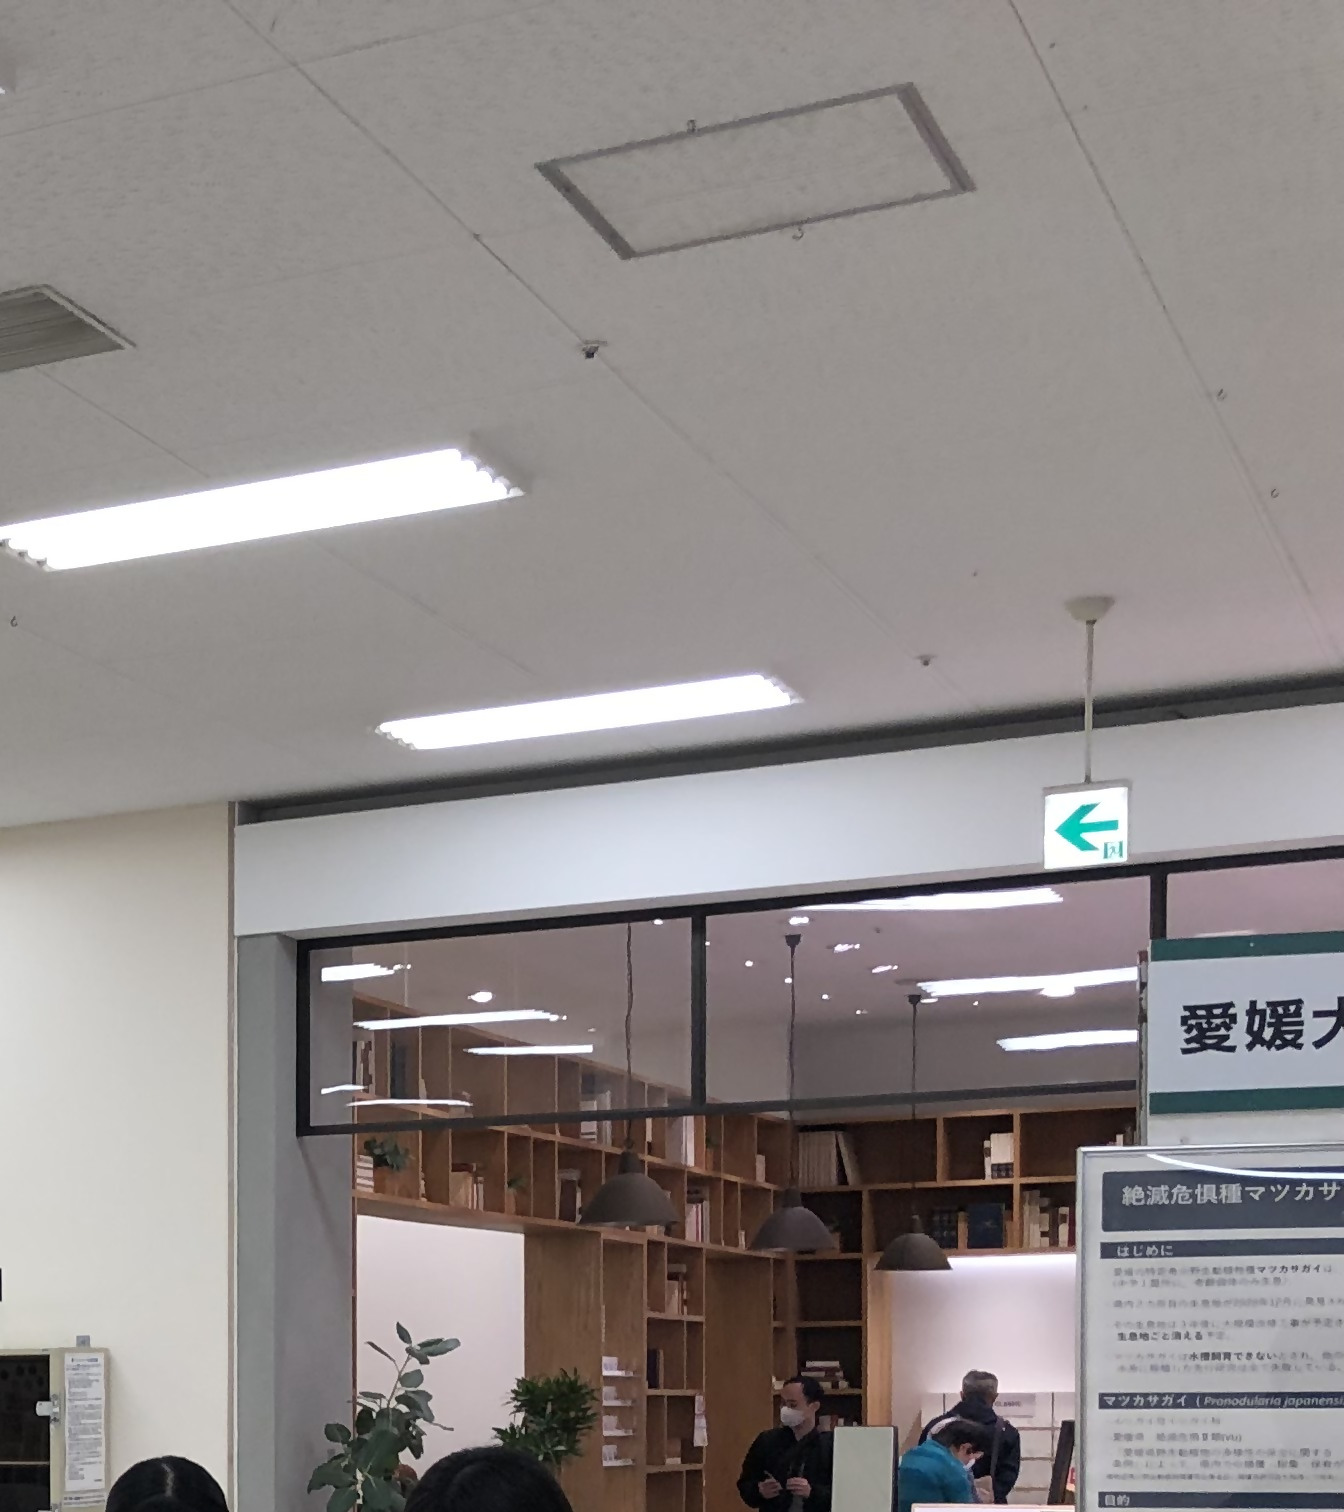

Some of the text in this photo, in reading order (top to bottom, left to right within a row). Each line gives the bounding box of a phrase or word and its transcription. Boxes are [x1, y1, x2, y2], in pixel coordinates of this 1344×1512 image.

[1122, 1181, 1342, 1206] 絶滅危惧種マツカサ
[1117, 1244, 1174, 1257] はじめに
[1103, 1395, 1188, 1407] マツカサガイ
[1104, 1495, 1130, 1506] 目的
